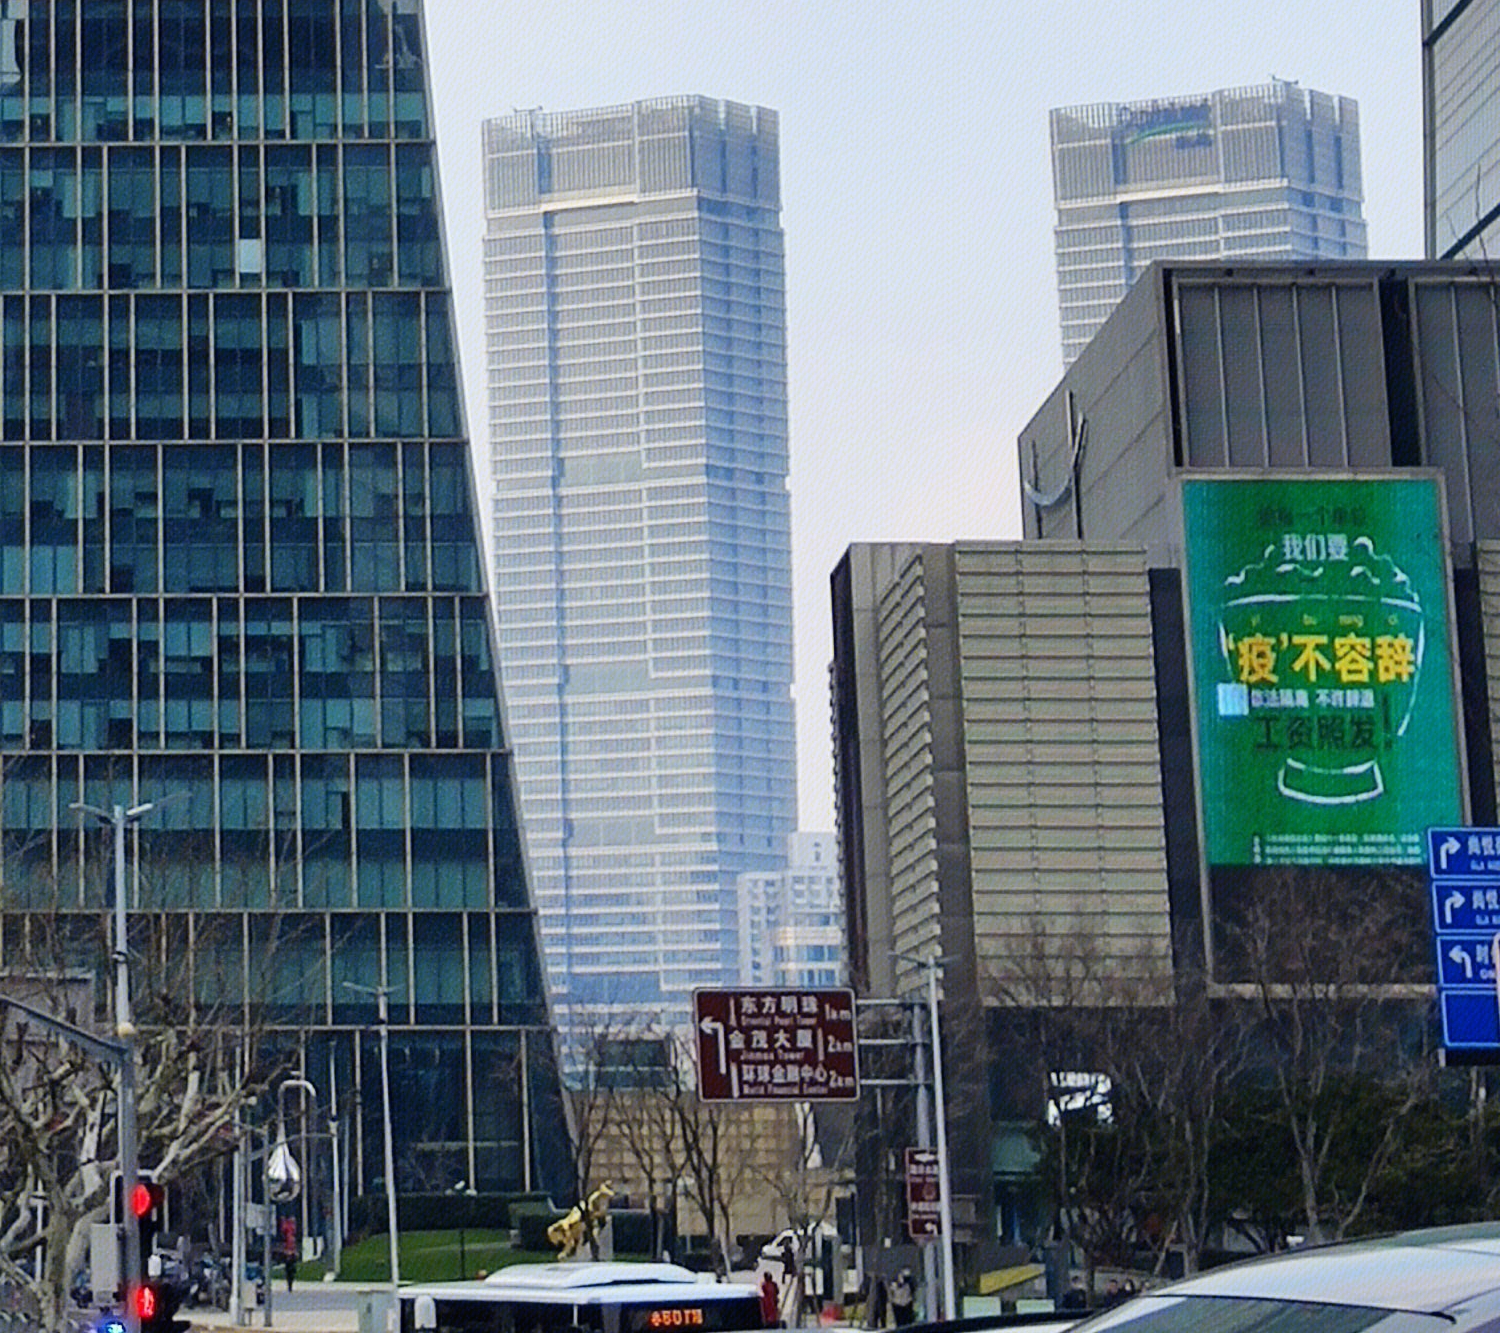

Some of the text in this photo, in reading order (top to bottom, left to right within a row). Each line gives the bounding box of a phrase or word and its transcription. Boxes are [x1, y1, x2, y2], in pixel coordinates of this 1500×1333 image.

[1283, 533, 1349, 562] 我们要
[740, 995, 819, 1014] 东方明珠
[729, 1028, 813, 1049] 金茂大厦
[741, 1063, 828, 1083] 环球金融中心
